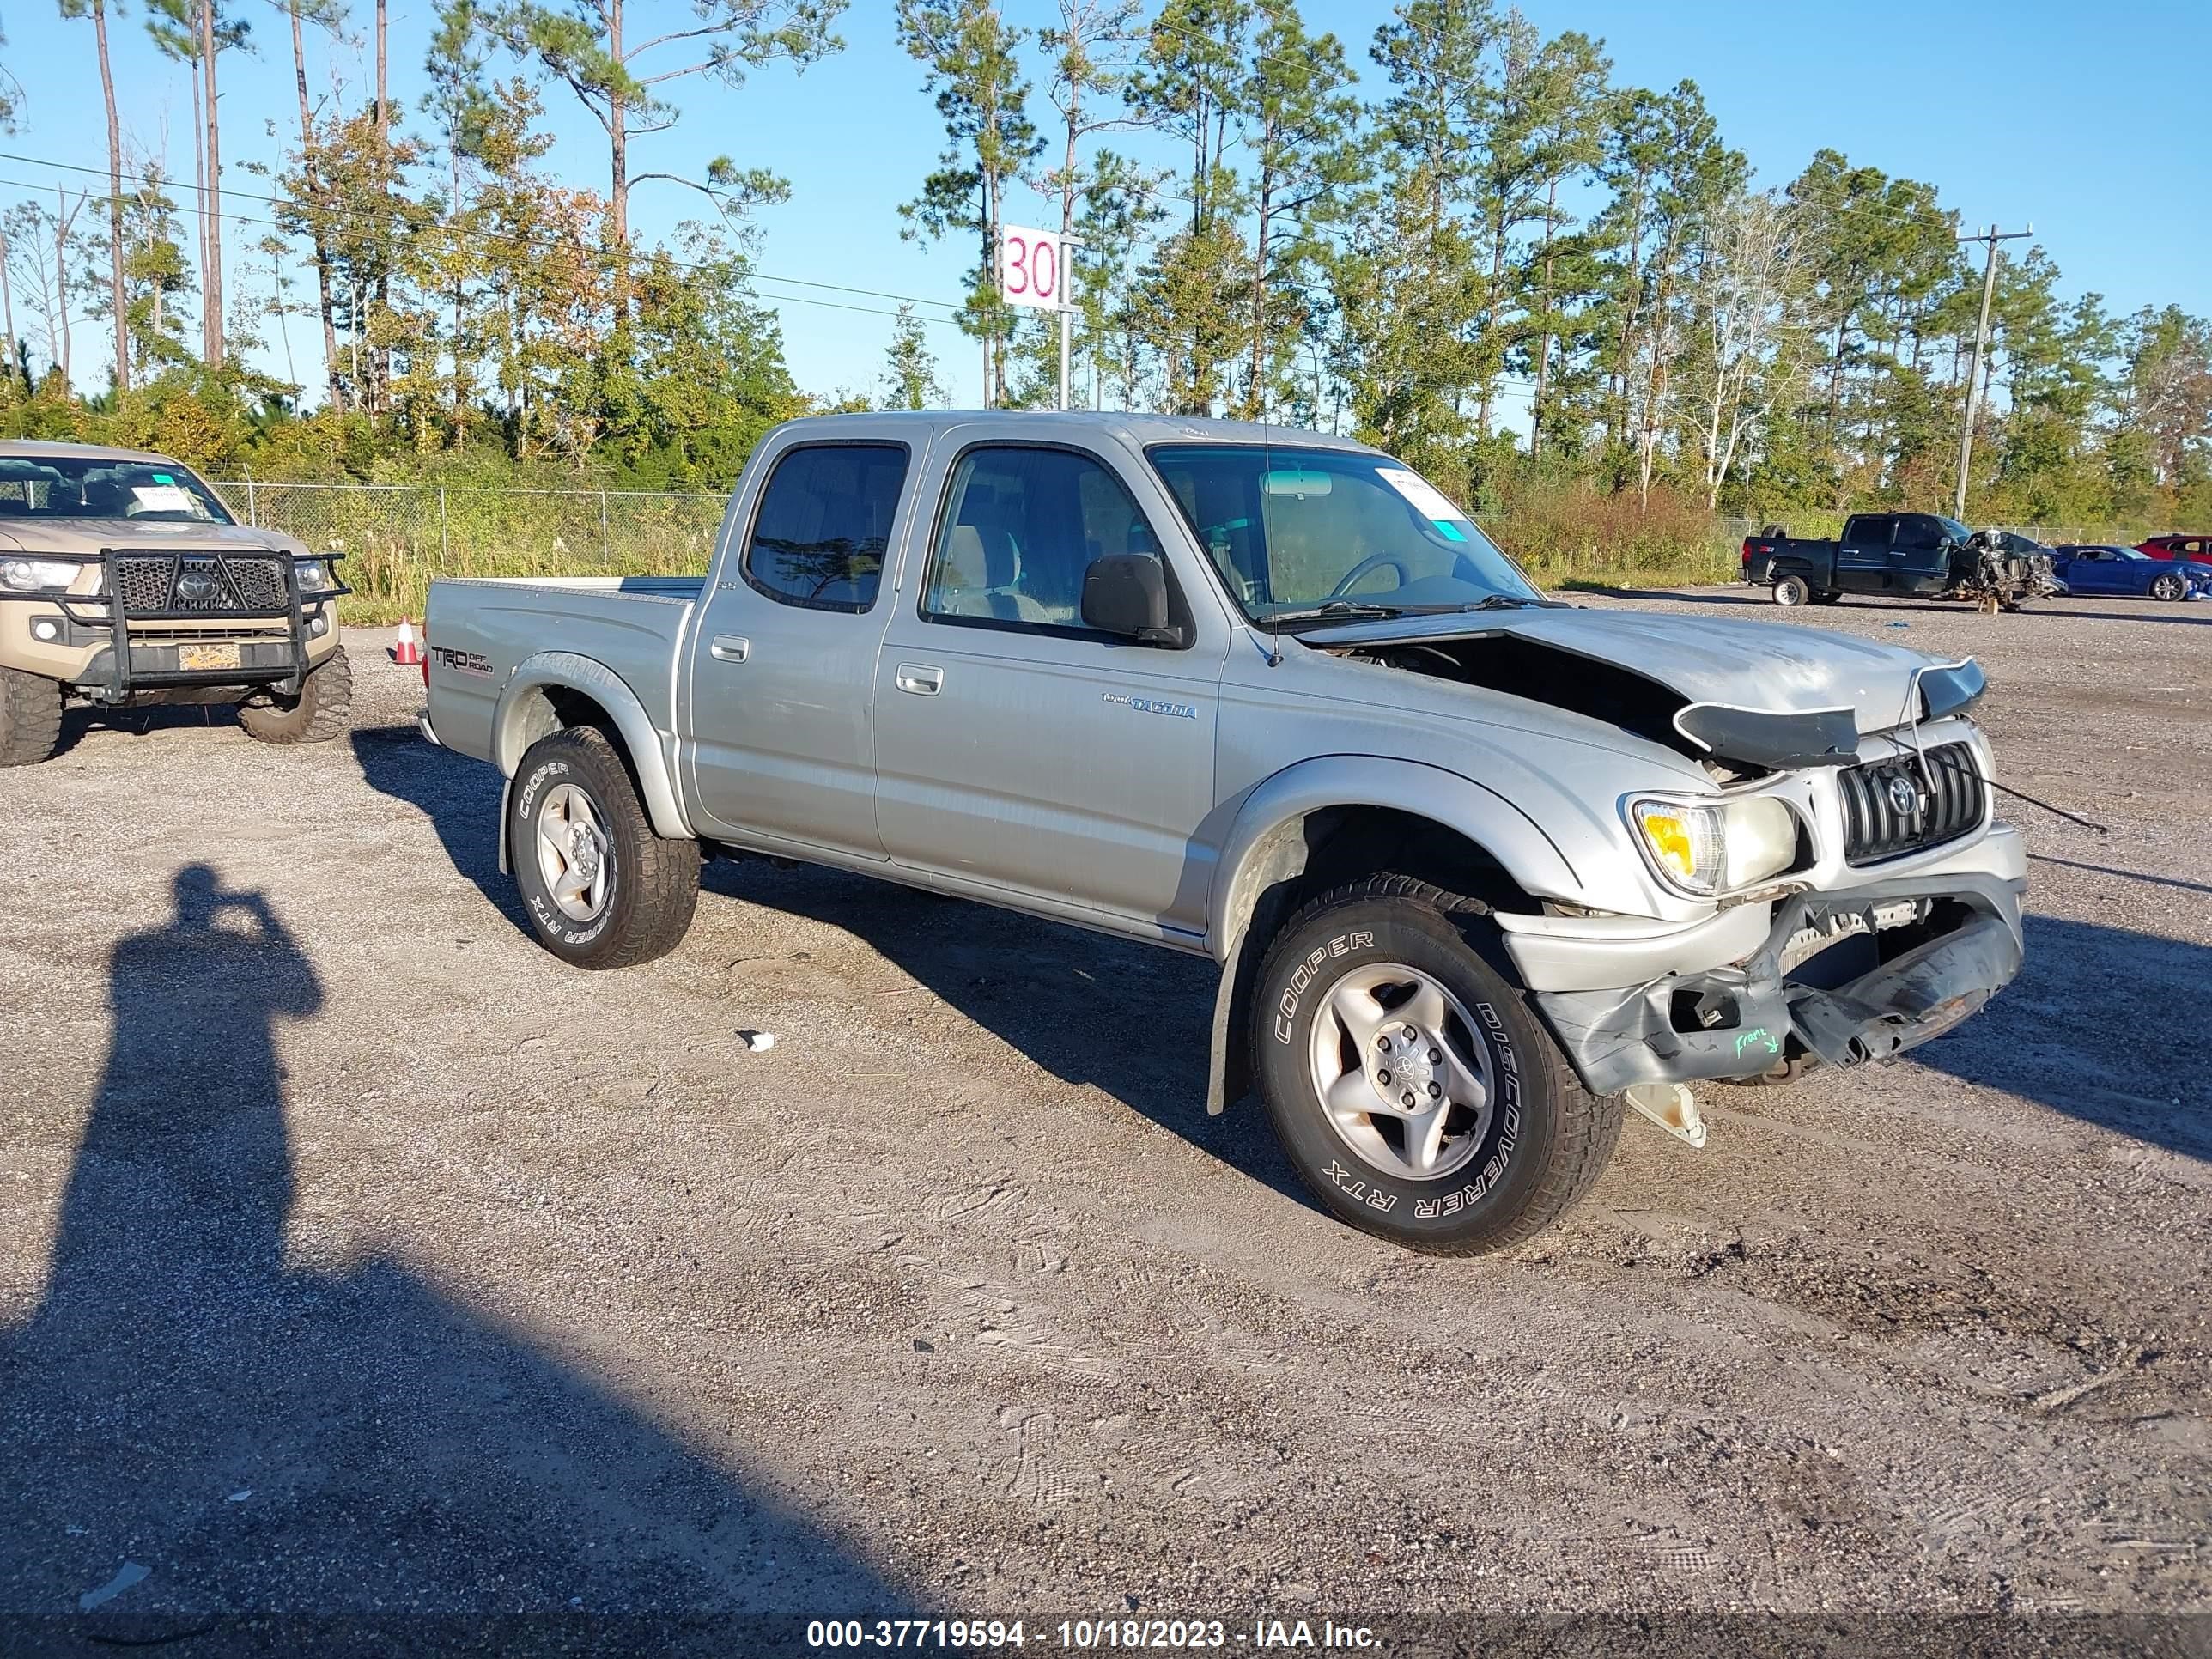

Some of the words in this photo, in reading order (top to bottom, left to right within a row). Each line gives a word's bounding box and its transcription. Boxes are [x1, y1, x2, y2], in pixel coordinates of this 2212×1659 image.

[1007, 237, 1055, 297] 30
[431, 646, 468, 670] TRD
[469, 653, 487, 662] OFF
[469, 662, 494, 673] ROAD
[519, 762, 570, 820] COOPER
[529, 895, 562, 935] RTX
[1274, 930, 1375, 1045] COOPER
[1413, 1001, 1522, 1218] DISCOVERER
[1321, 1159, 1399, 1213] RTX
